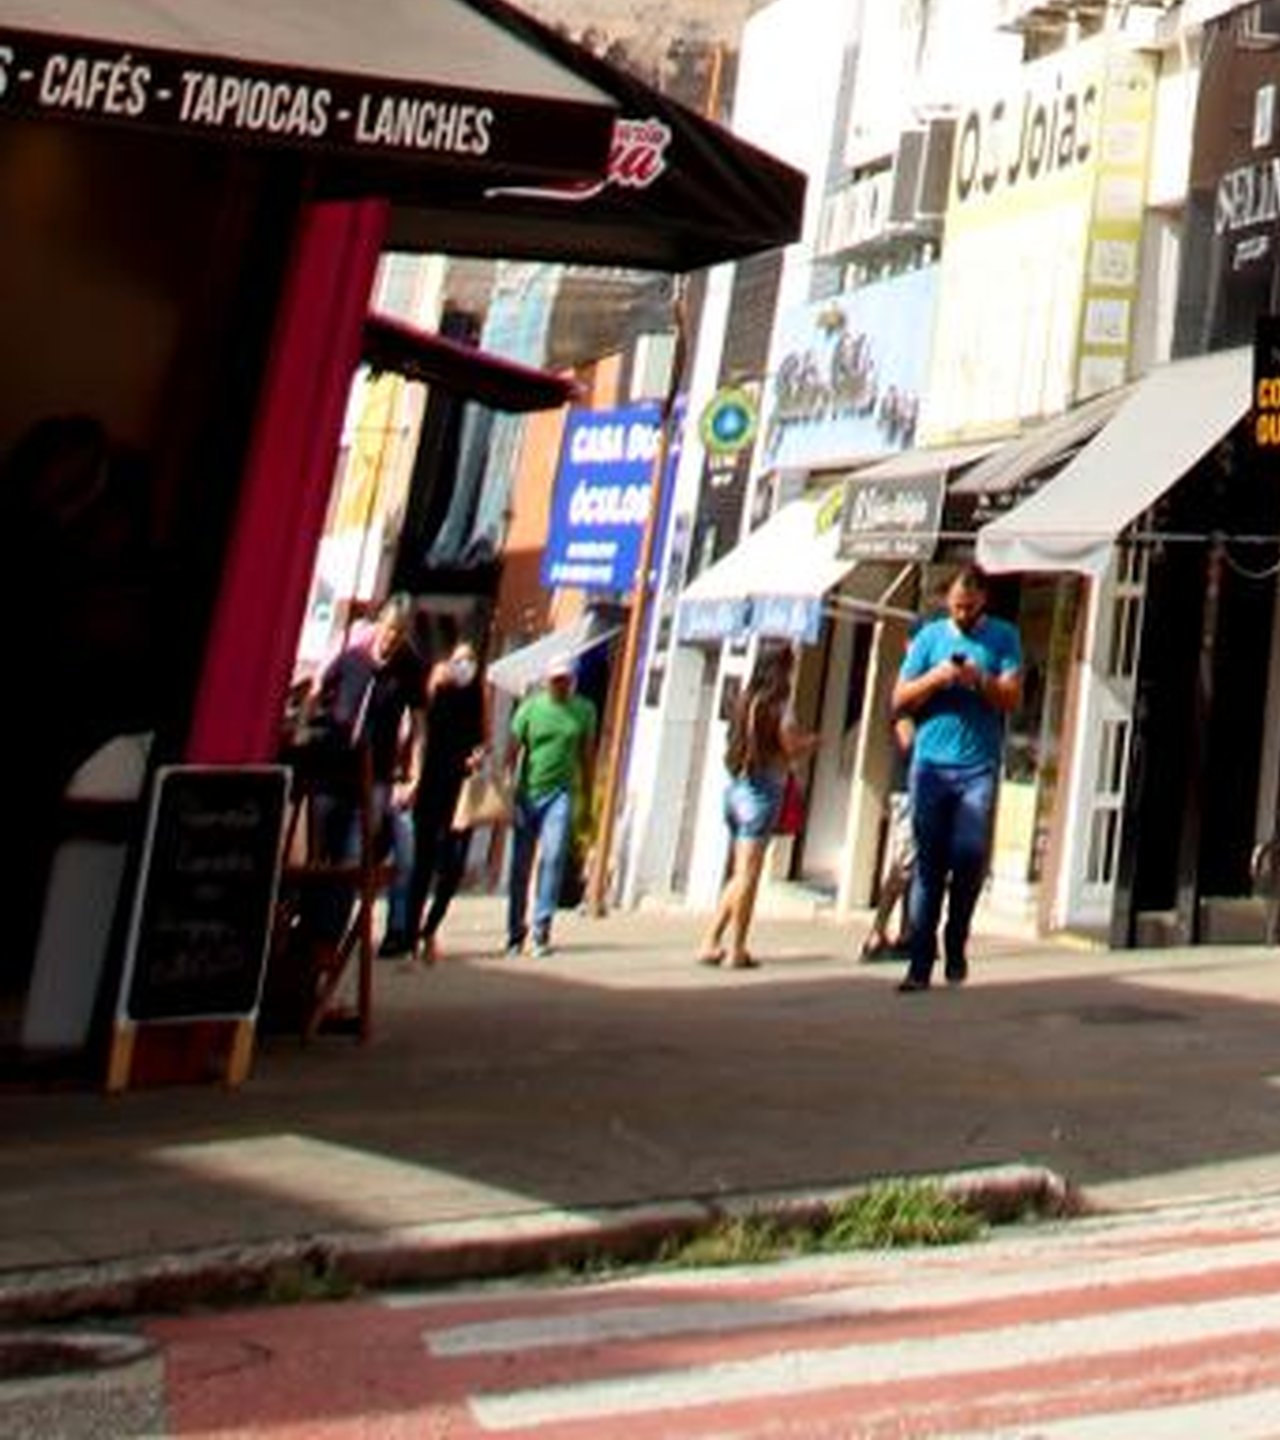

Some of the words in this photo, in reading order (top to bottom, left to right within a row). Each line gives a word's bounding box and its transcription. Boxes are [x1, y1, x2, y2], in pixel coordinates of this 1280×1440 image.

[39, 51, 151, 117] CAFÉS
[178, 69, 332, 137] TAPIOCAS
[356, 93, 495, 155] LANCHES
